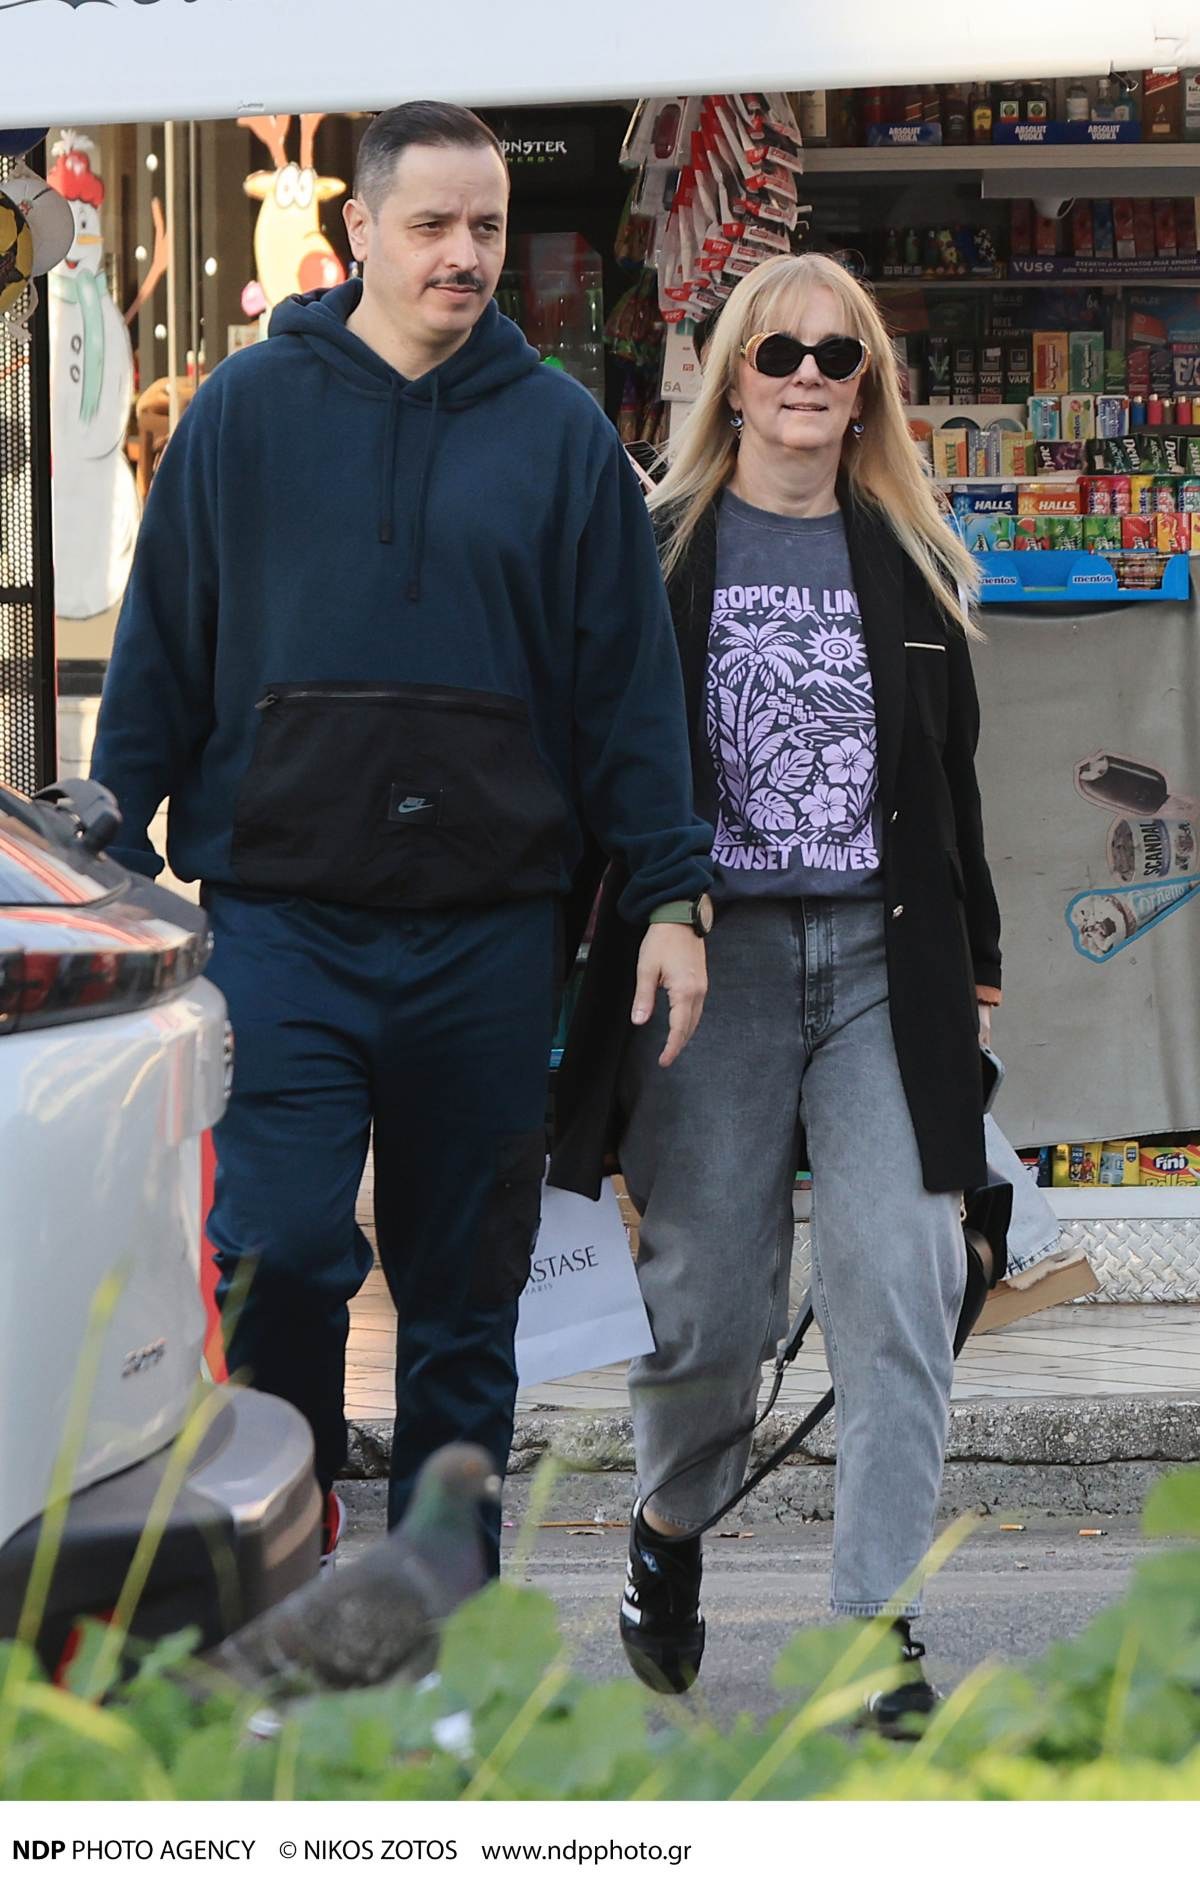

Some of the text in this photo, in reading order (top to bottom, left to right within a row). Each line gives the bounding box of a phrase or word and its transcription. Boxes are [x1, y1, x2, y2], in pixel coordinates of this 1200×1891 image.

[889, 127, 921, 135] ABSOLUT
[1015, 125, 1047, 134] ABSOLUT
[1088, 125, 1120, 133] ABSOLUT
[974, 500, 1012, 511] HALLS
[1038, 500, 1077, 511] HALLS
[1073, 575, 1112, 584] mentos
[1139, 822, 1161, 877] SCANDAL
[710, 842, 880, 872] SUNSET WAVES
[1155, 1153, 1186, 1171] Fini
